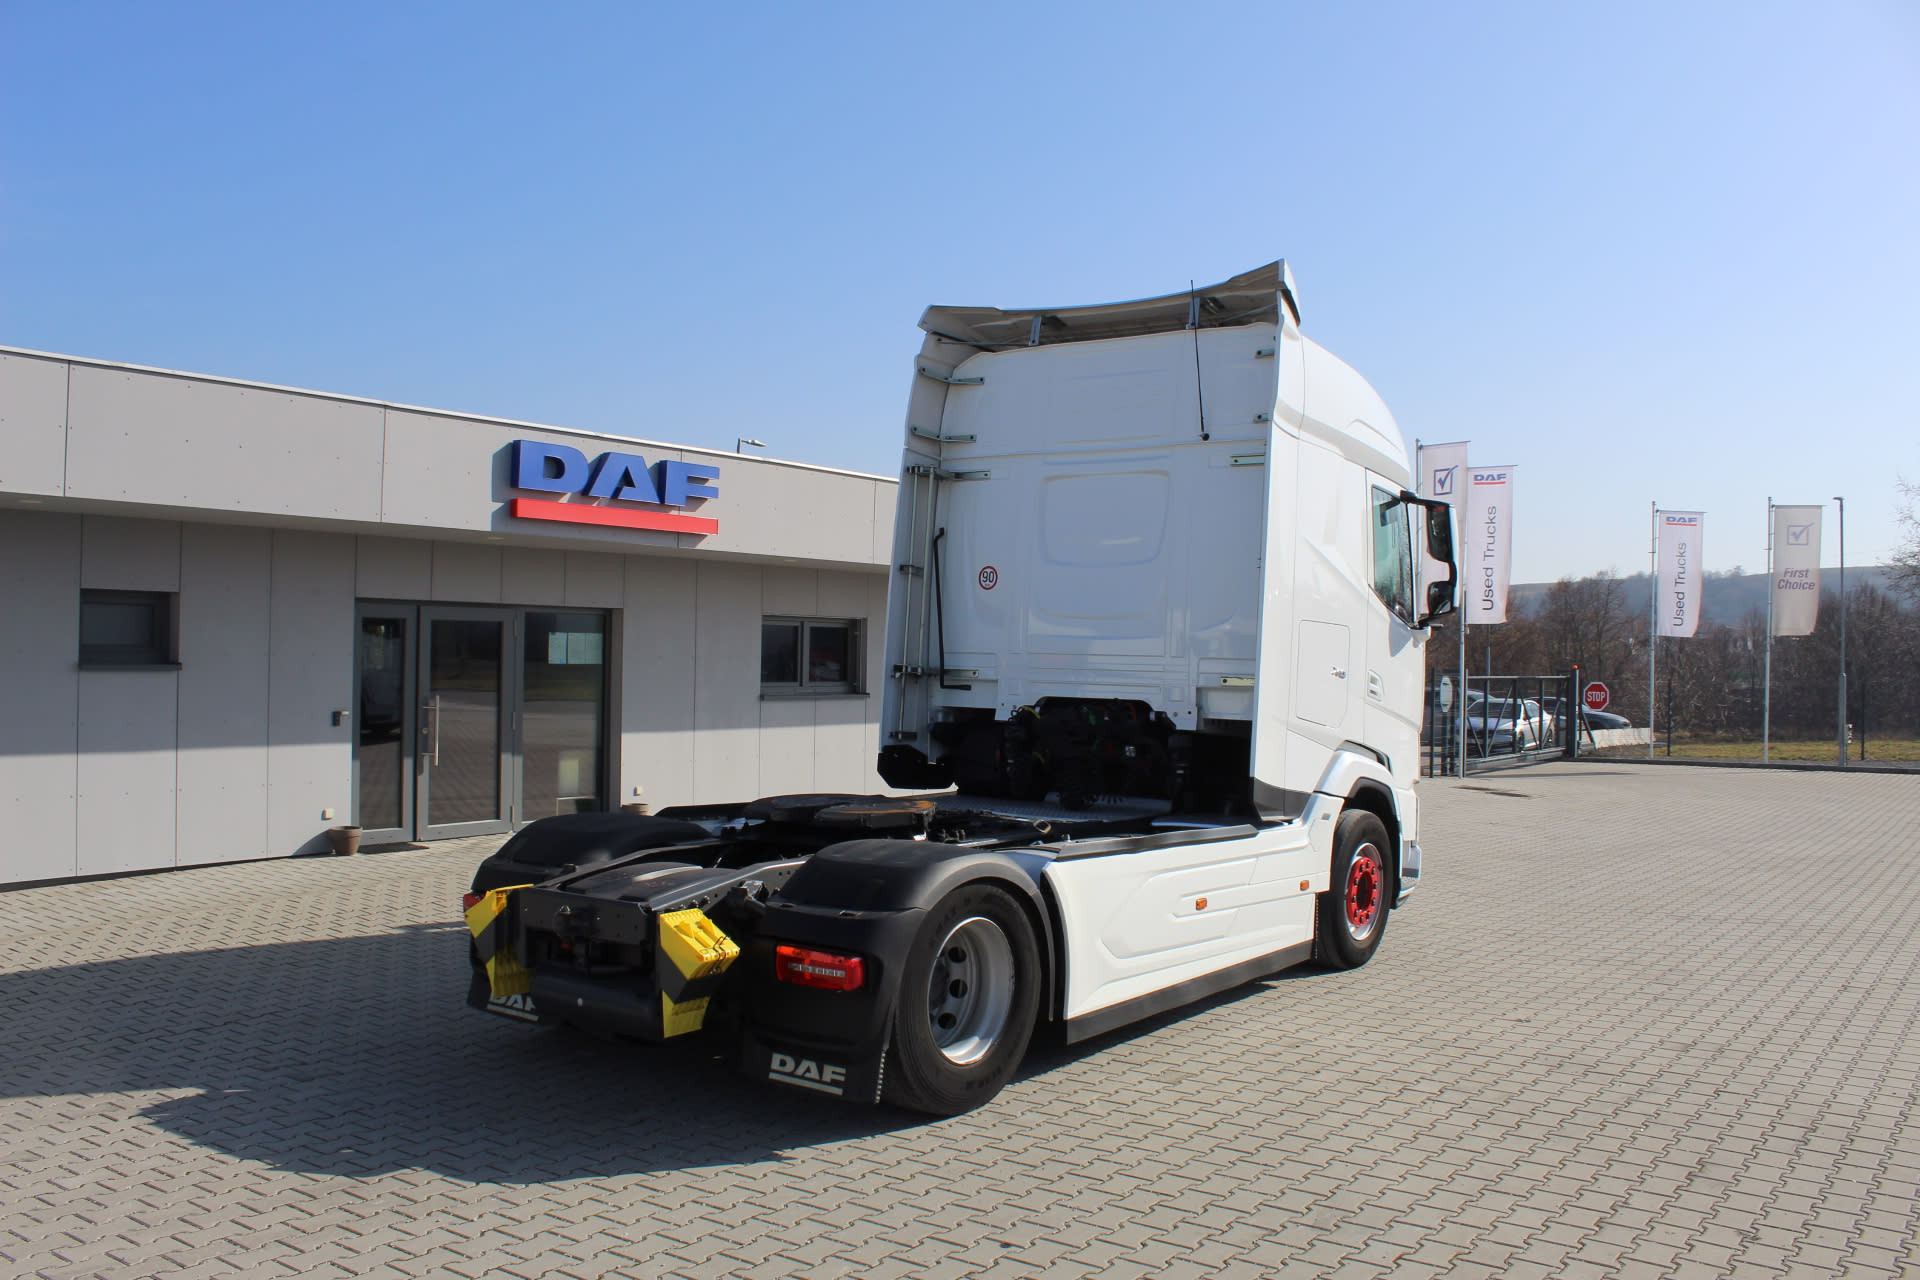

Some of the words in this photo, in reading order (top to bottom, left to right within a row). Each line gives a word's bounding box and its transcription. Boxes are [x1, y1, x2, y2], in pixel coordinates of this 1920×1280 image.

[510, 439, 720, 507] DAF
[1473, 473, 1507, 482] DAF
[1482, 505, 1498, 561] Trucks
[982, 570, 995, 583] 90
[1674, 542, 1687, 588] Trucks
[1783, 567, 1809, 579] First
[1481, 567, 1495, 611] Used
[1777, 578, 1816, 591] Choice
[1672, 591, 1686, 628] Used
[1587, 691, 1606, 702] STOP
[770, 1052, 847, 1084] DAF
